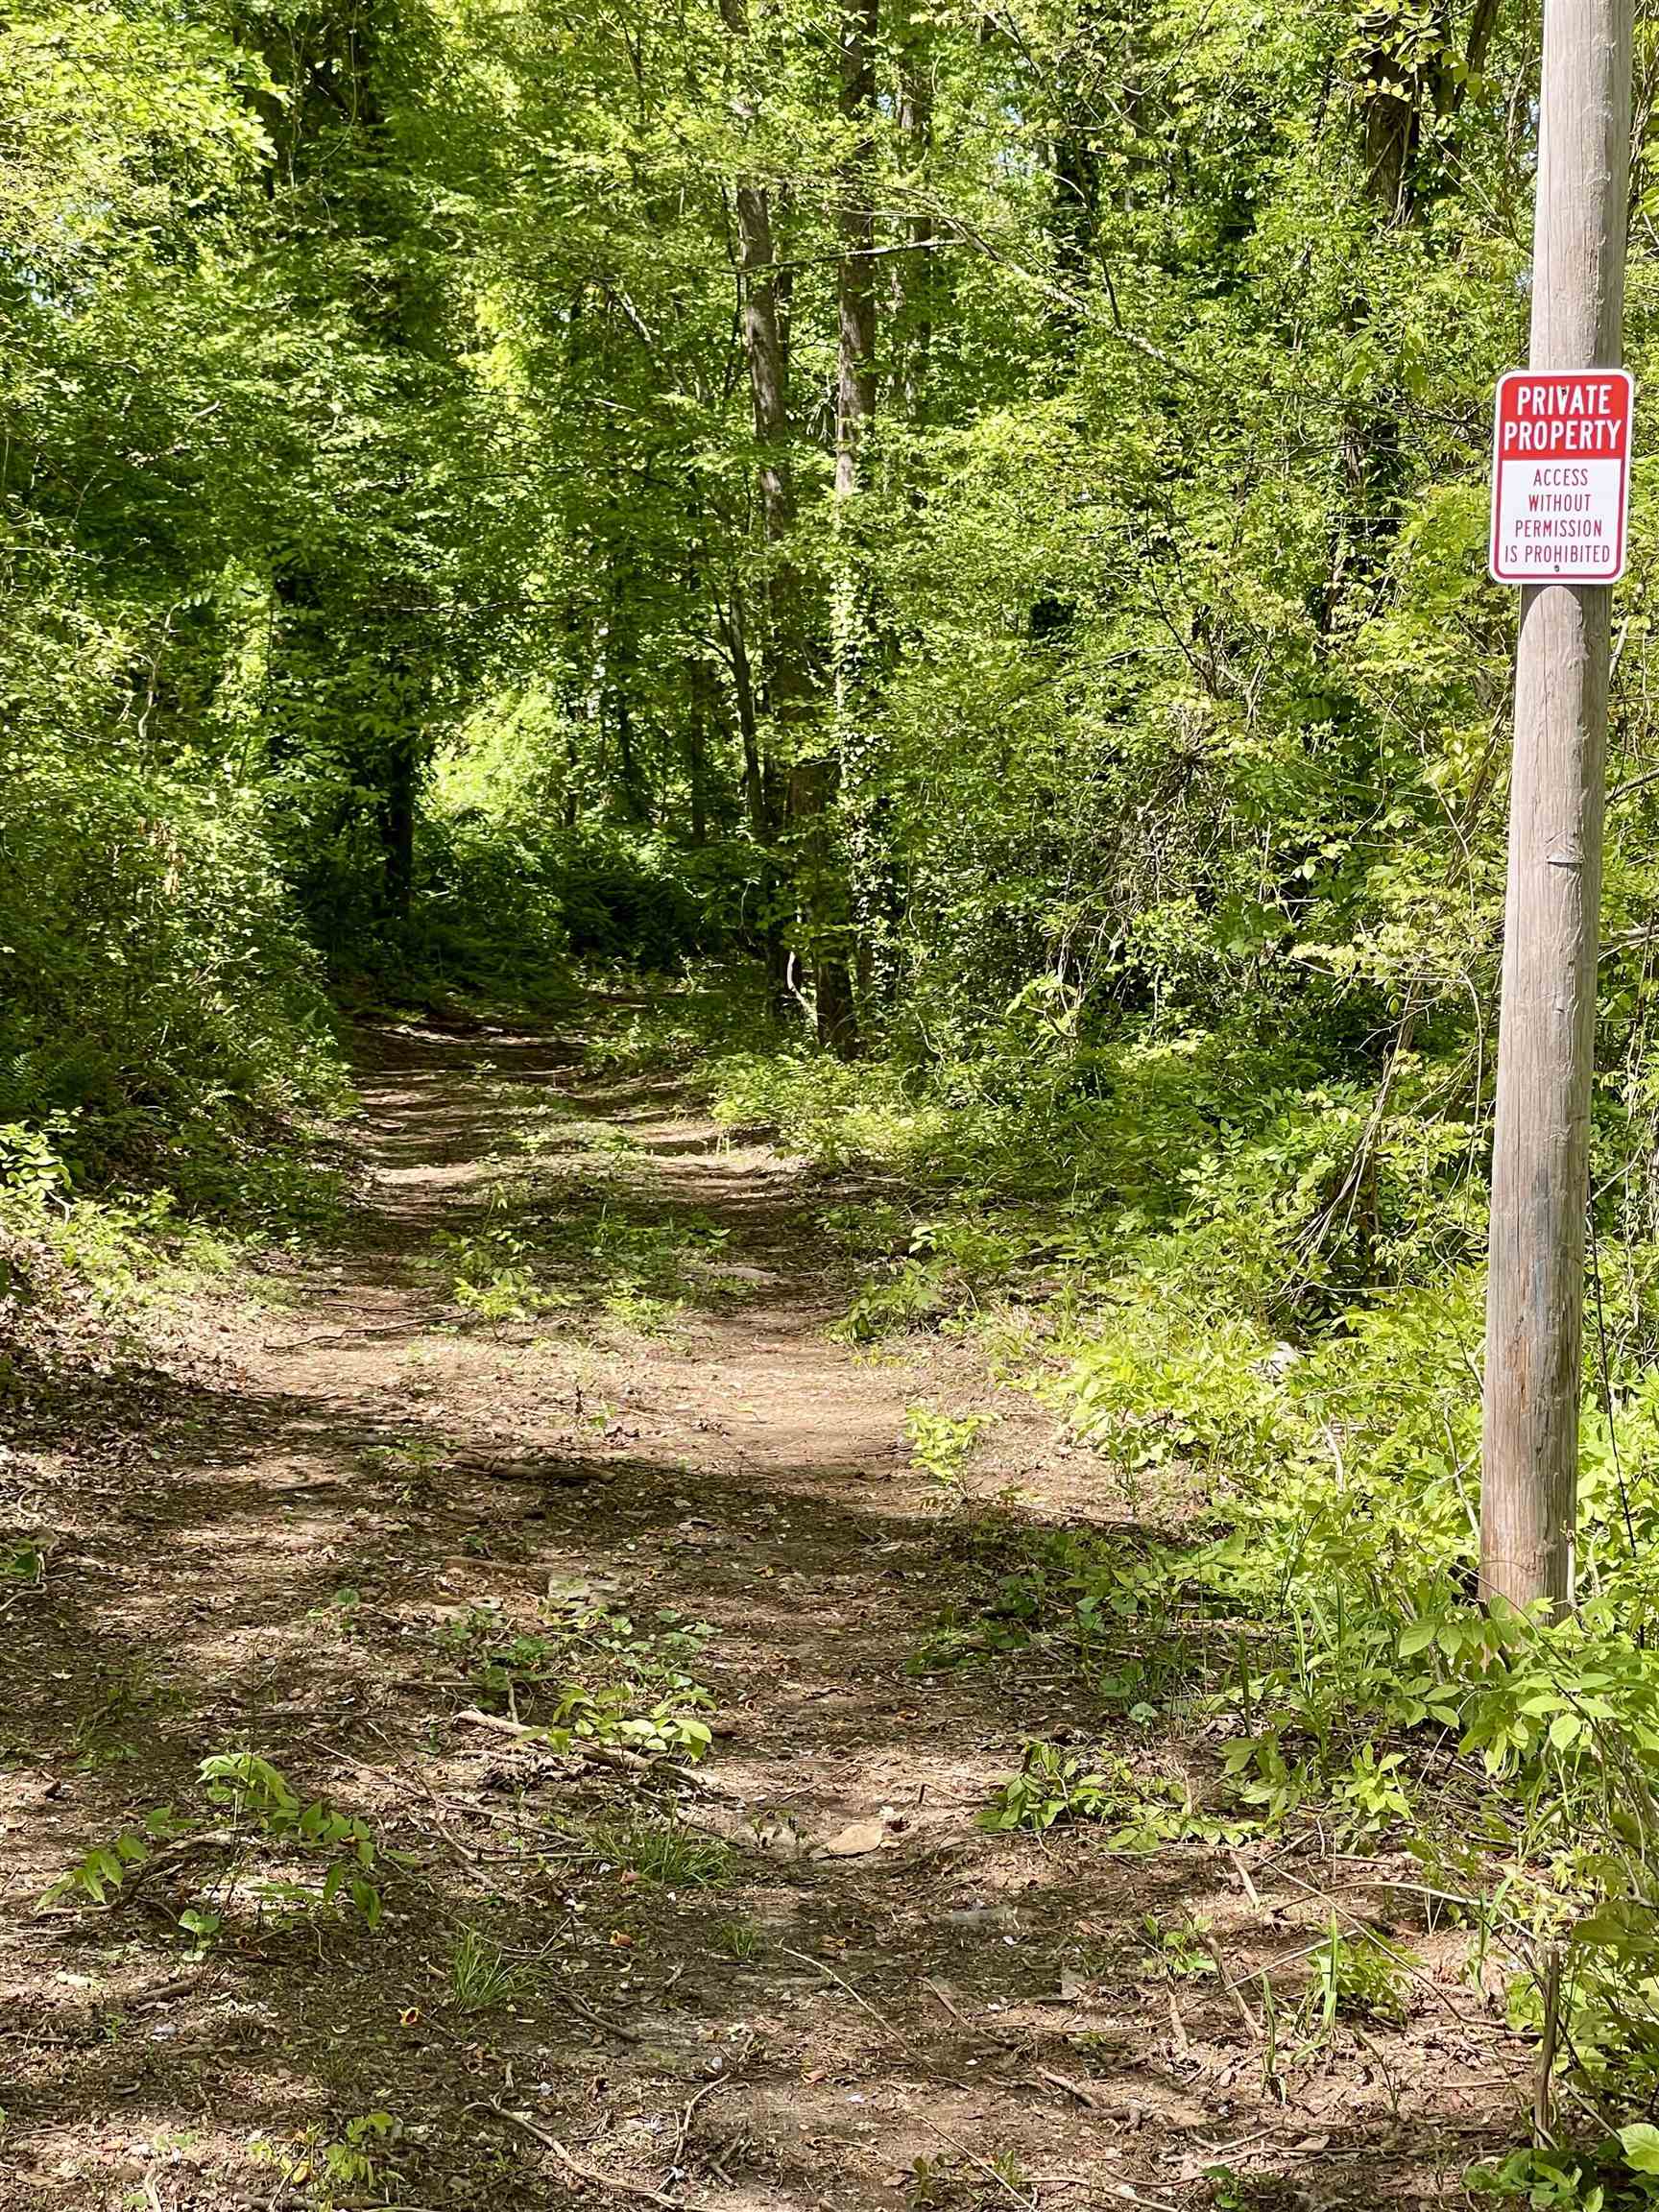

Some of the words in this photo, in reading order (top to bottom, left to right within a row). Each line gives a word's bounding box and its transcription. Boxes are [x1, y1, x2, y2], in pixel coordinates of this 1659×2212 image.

[1517, 384, 1613, 416] PRIVATE
[1503, 420, 1622, 451] PROPERTY
[1533, 469, 1588, 487] ACCESS
[1528, 493, 1592, 512] WITHOUT
[1515, 519, 1602, 538] PERMISSION
[1504, 544, 1518, 563] IS
[1525, 544, 1610, 563] PROHIBITED
